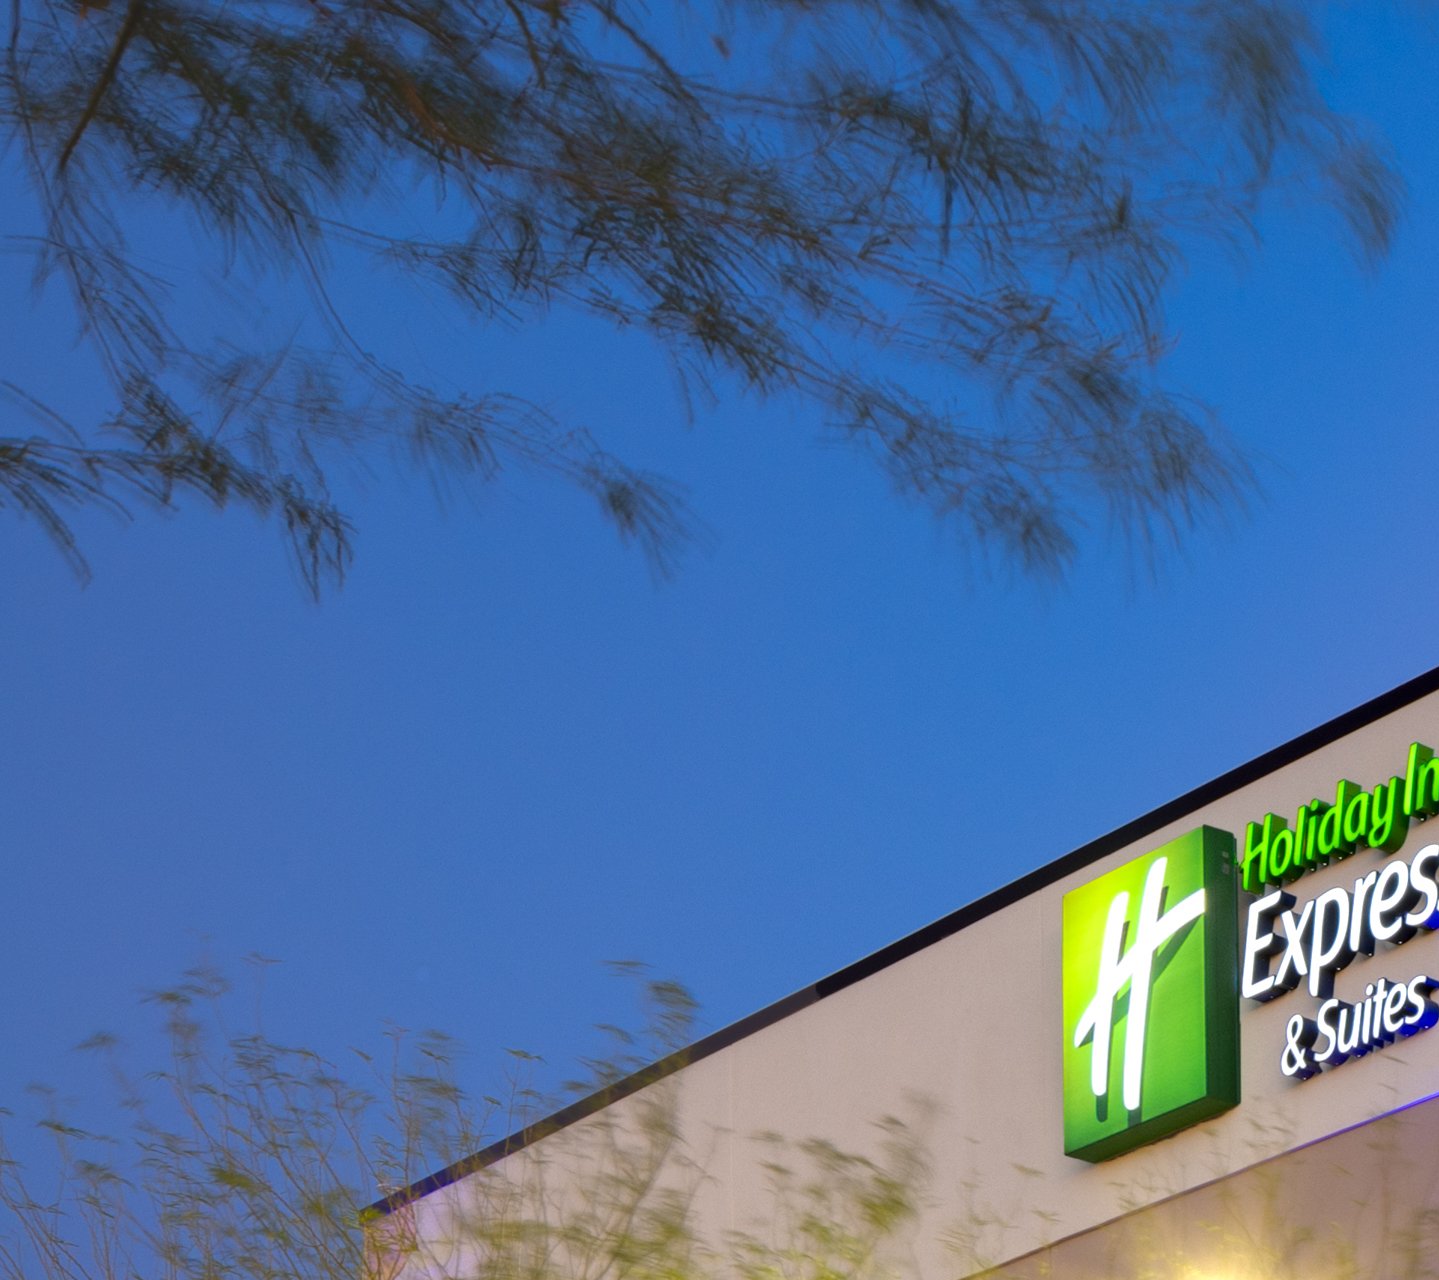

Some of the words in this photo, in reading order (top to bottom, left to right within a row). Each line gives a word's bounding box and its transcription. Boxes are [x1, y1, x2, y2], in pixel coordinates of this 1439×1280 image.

[1241, 775, 1403, 892] Holiday
[1281, 1014, 1310, 1078] &
[1314, 975, 1434, 1063] Suites
